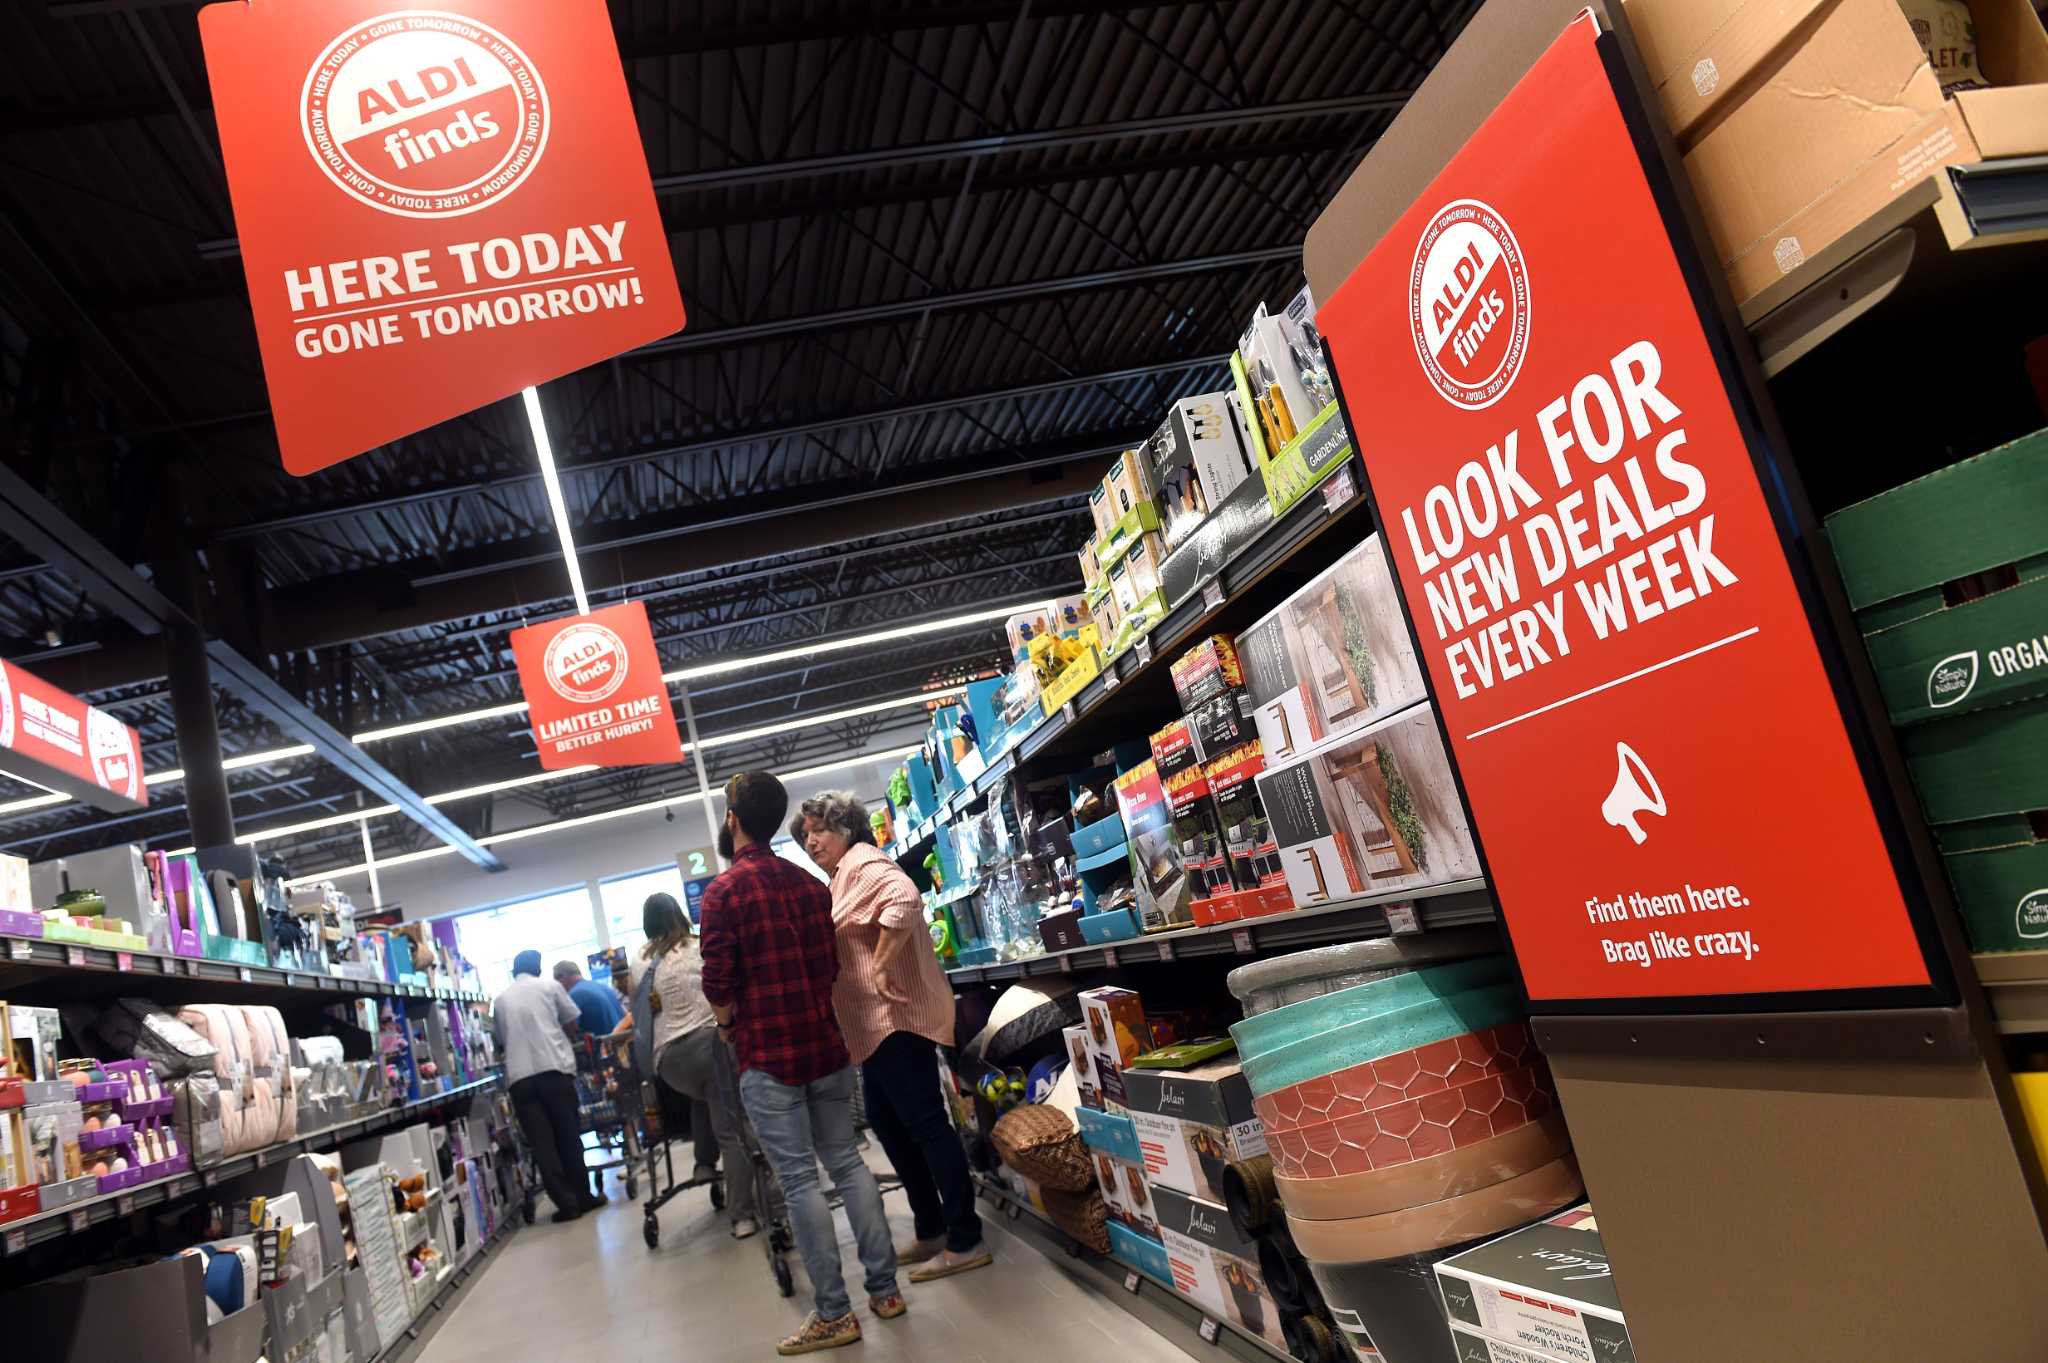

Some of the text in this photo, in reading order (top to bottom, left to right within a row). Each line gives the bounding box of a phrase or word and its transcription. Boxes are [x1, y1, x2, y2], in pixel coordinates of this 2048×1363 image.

[369, 18, 481, 40] GONE TOMORROW
[313, 37, 359, 97] HERE TODAY
[357, 57, 478, 125] ALDI
[490, 42, 538, 101] HERE TODAY
[312, 109, 376, 195] GONE TOMORROW
[384, 109, 500, 170] finds
[481, 112, 540, 196] GONE TOMORROW
[387, 194, 470, 209] HERE TODAY
[1424, 208, 1476, 249] GONE TOMORROW
[284, 220, 627, 313] HERE TODAY
[1482, 214, 1518, 264] HERE TODAY
[1413, 256, 1425, 320] HERE TODAY
[1432, 241, 1484, 335] ALDI
[295, 277, 645, 359] GONE TOMORROW!
[1452, 288, 1505, 368] finds
[1506, 275, 1526, 373] GONE TOMORROW
[1417, 331, 1459, 397] GONE TOMORROW
[1466, 376, 1504, 401] HERE TODAY
[1309, 427, 1348, 467] GARDENLINE
[1401, 340, 1683, 576] LOOK FOR
[1423, 428, 1706, 640] NEW DEALS
[1444, 514, 1739, 700] EVERY WEEK
[563, 641, 602, 670] ALDI
[572, 659, 611, 686] finds
[539, 695, 662, 740] LIMITED TIME
[555, 718, 653, 753] BETTER HURRY!
[1295, 768, 1320, 836] Raised Planter
[1300, 766, 1315, 807] Wooden
[687, 852, 708, 876] 2
[1585, 883, 1750, 924] Find them here.
[1601, 930, 1760, 968] Brag like crazy.
[1517, 1330, 1549, 1349] Wooden
[1534, 1324, 1586, 1349] Porch Rocker
